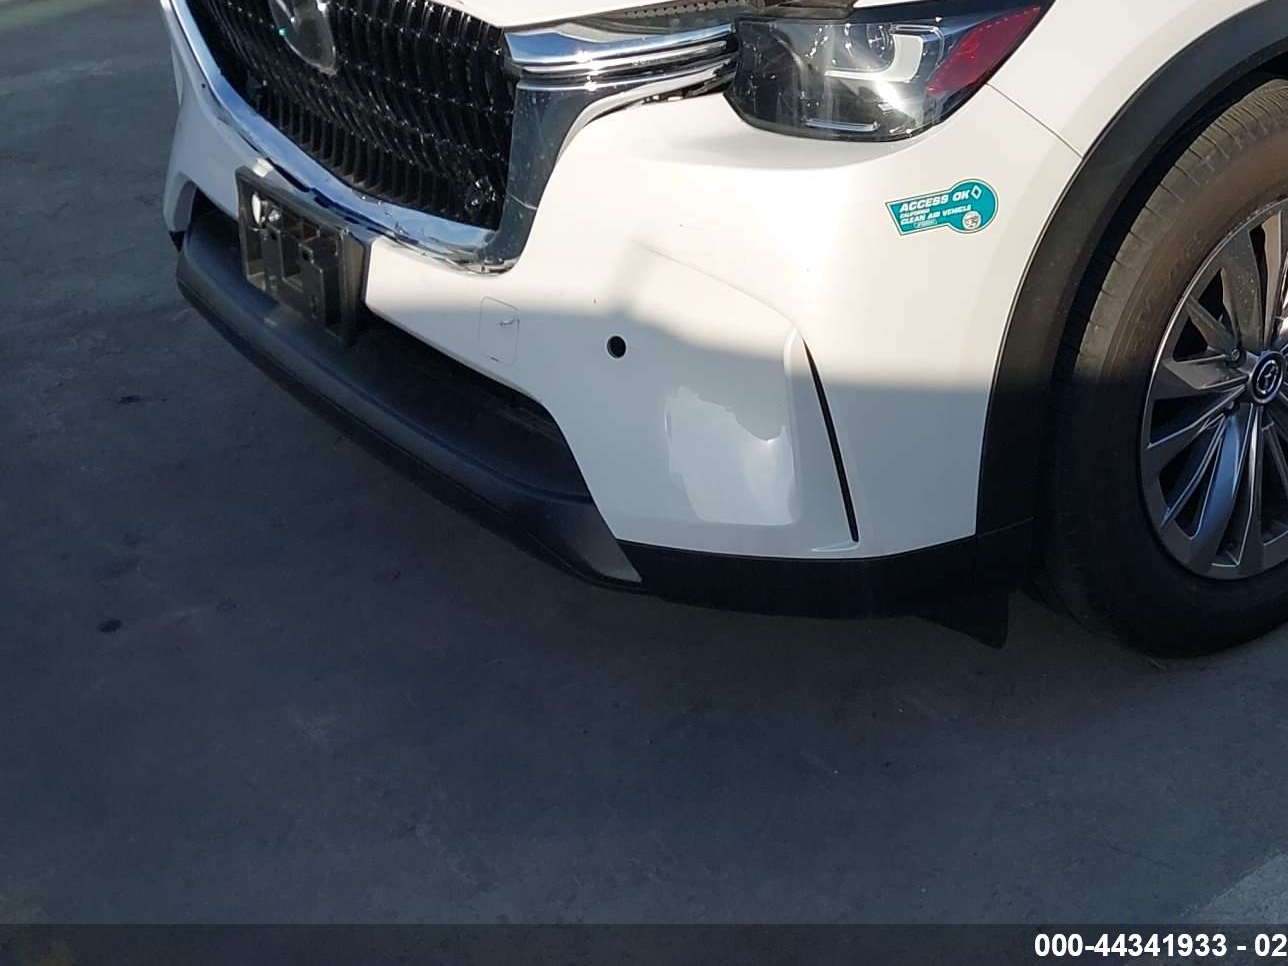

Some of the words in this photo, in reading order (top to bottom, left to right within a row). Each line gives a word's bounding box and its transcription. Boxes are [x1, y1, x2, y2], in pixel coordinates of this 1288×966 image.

[900, 195, 949, 212] ACCESS
[952, 190, 970, 202] OK
[900, 214, 926, 225] CLEAN
[927, 211, 941, 220] AIR
[943, 205, 972, 216] VEHICLE
